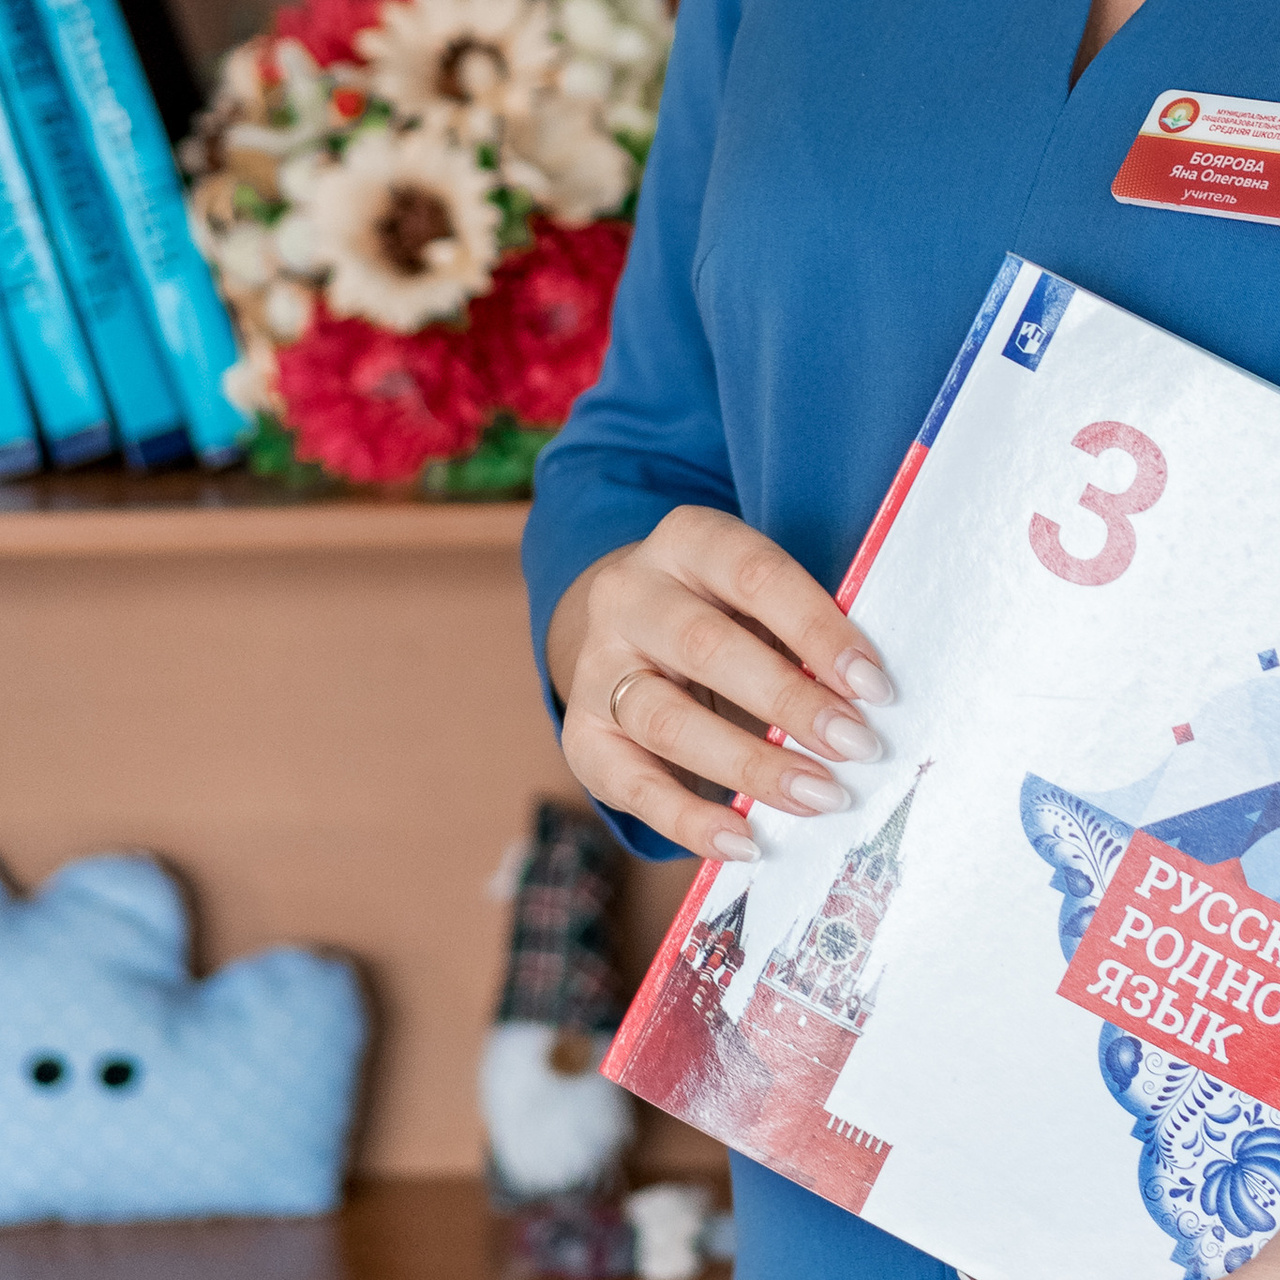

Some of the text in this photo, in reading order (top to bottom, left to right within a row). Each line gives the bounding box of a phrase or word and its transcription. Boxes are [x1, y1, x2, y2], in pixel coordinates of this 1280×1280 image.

[1216, 108, 1277, 122] МУНИЦИПАЛЬНОЕ
[1208, 124, 1251, 136] СРЕДНЯЯ
[1189, 151, 1265, 173] БОЯРОВА
[1169, 164, 1270, 190] Яна Олеговна
[1180, 188, 1238, 205] учитель
[1028, 420, 1168, 587] 3
[1086, 958, 1244, 1064] ЯЗЫК
